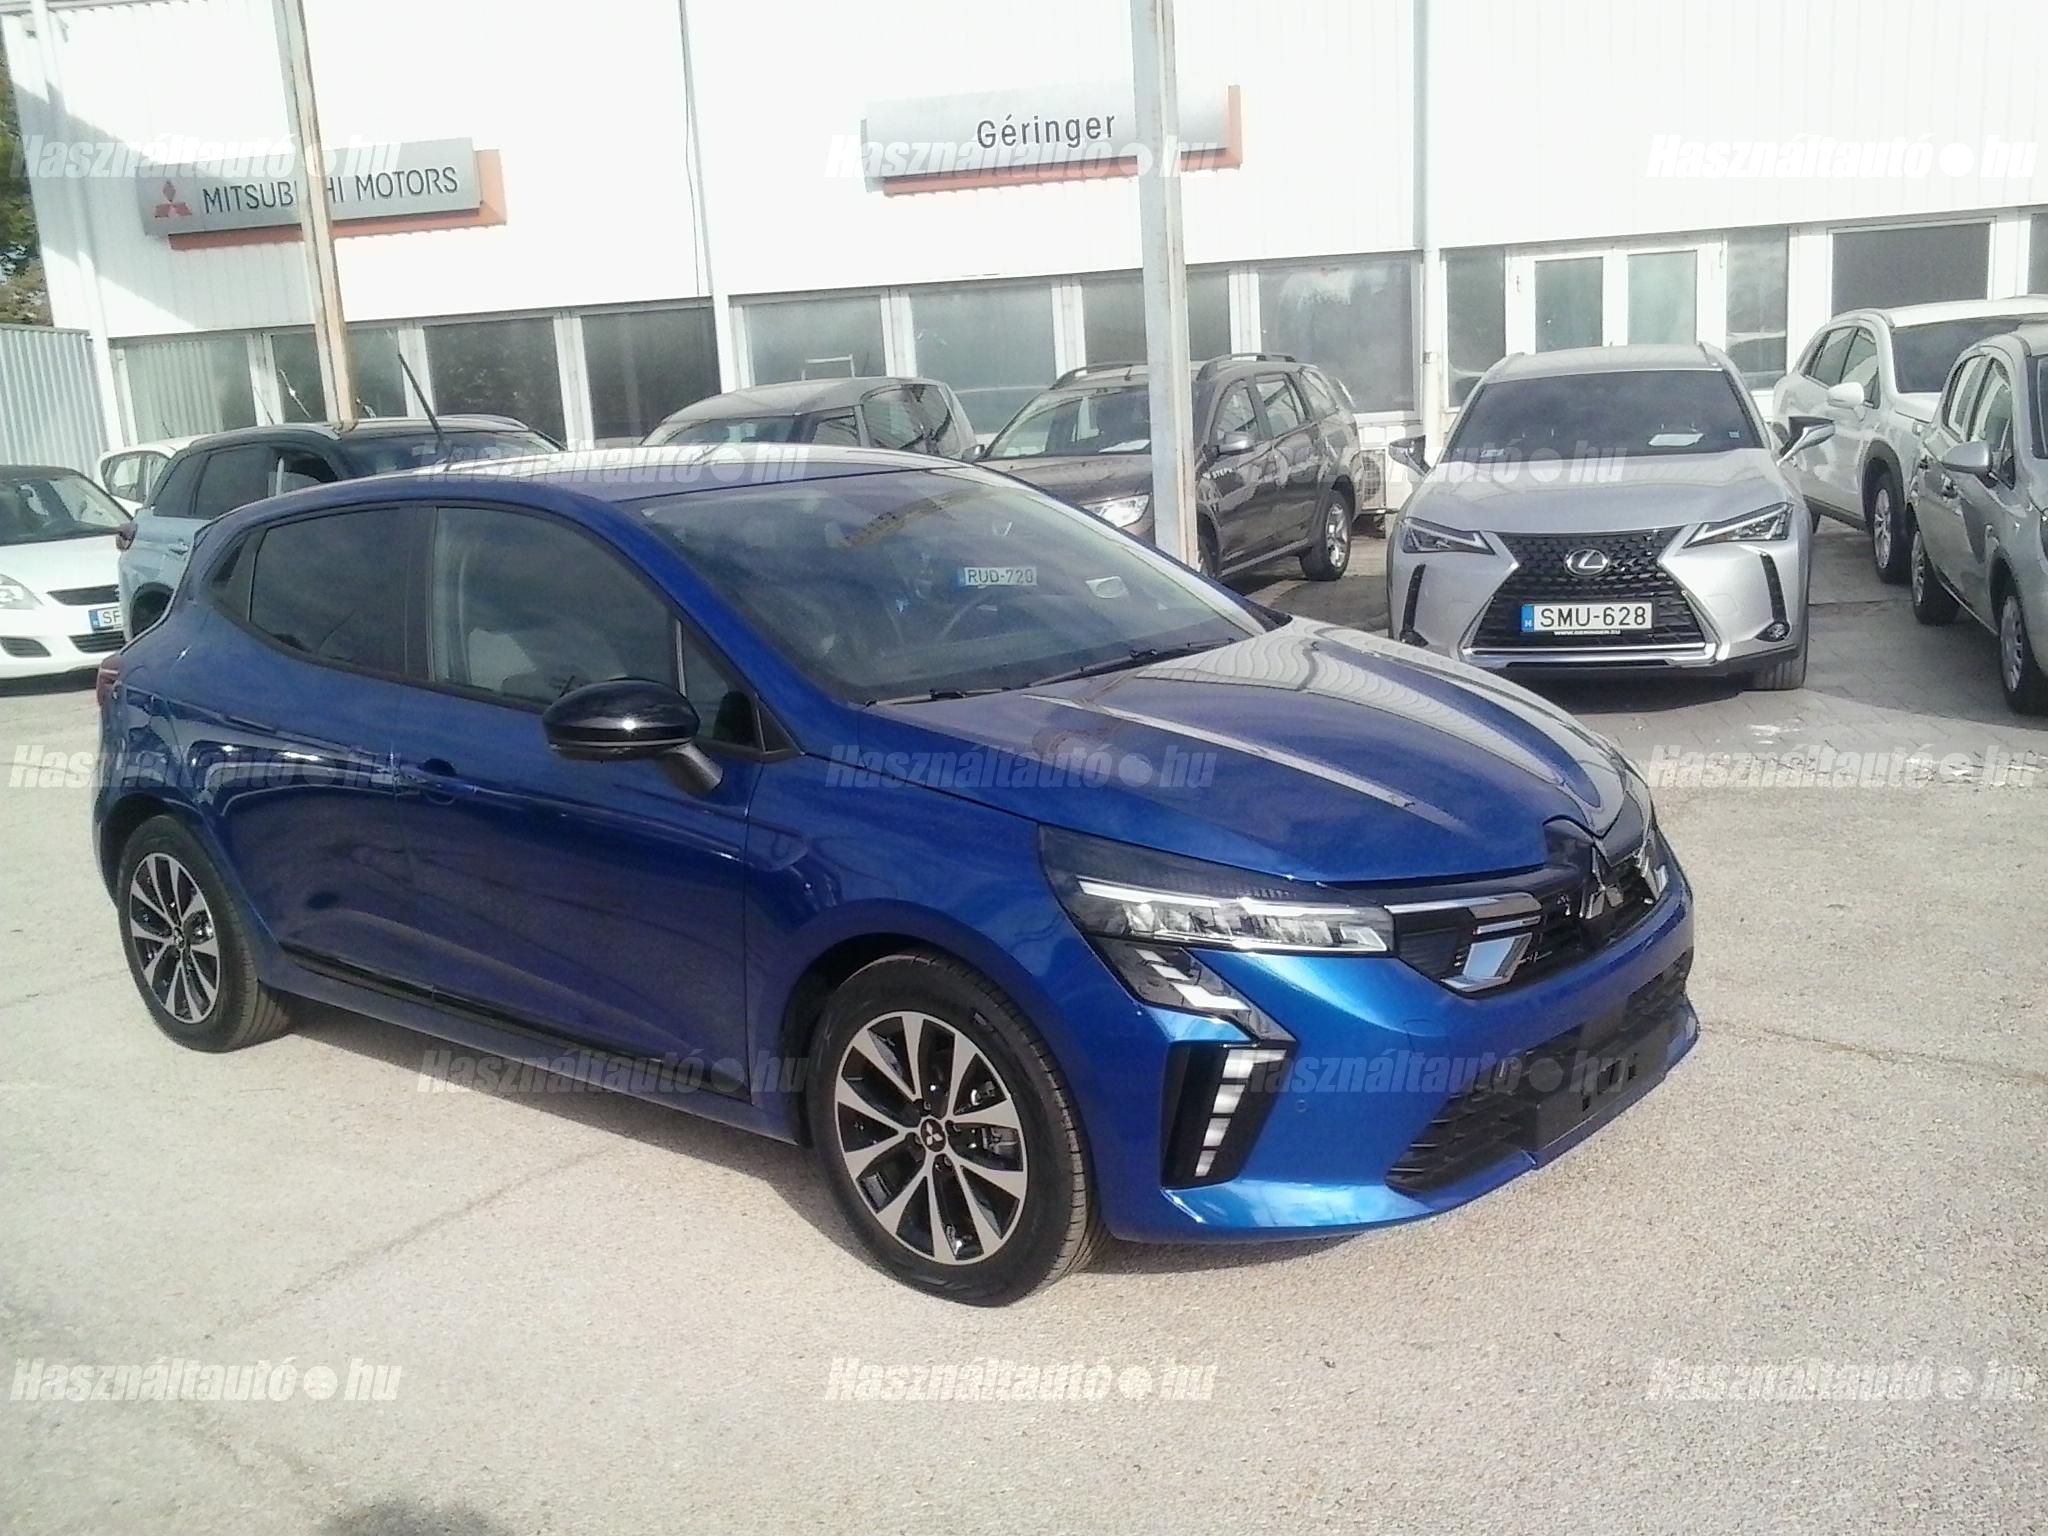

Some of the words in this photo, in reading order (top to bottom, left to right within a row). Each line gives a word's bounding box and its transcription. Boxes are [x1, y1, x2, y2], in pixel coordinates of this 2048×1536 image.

[976, 113, 1116, 149] Géringer
[203, 175, 344, 214] MITSUBIHI
[356, 166, 459, 202] MOTORS
[967, 567, 1034, 584] RUD-720
[1540, 605, 1647, 628] SMU-628
